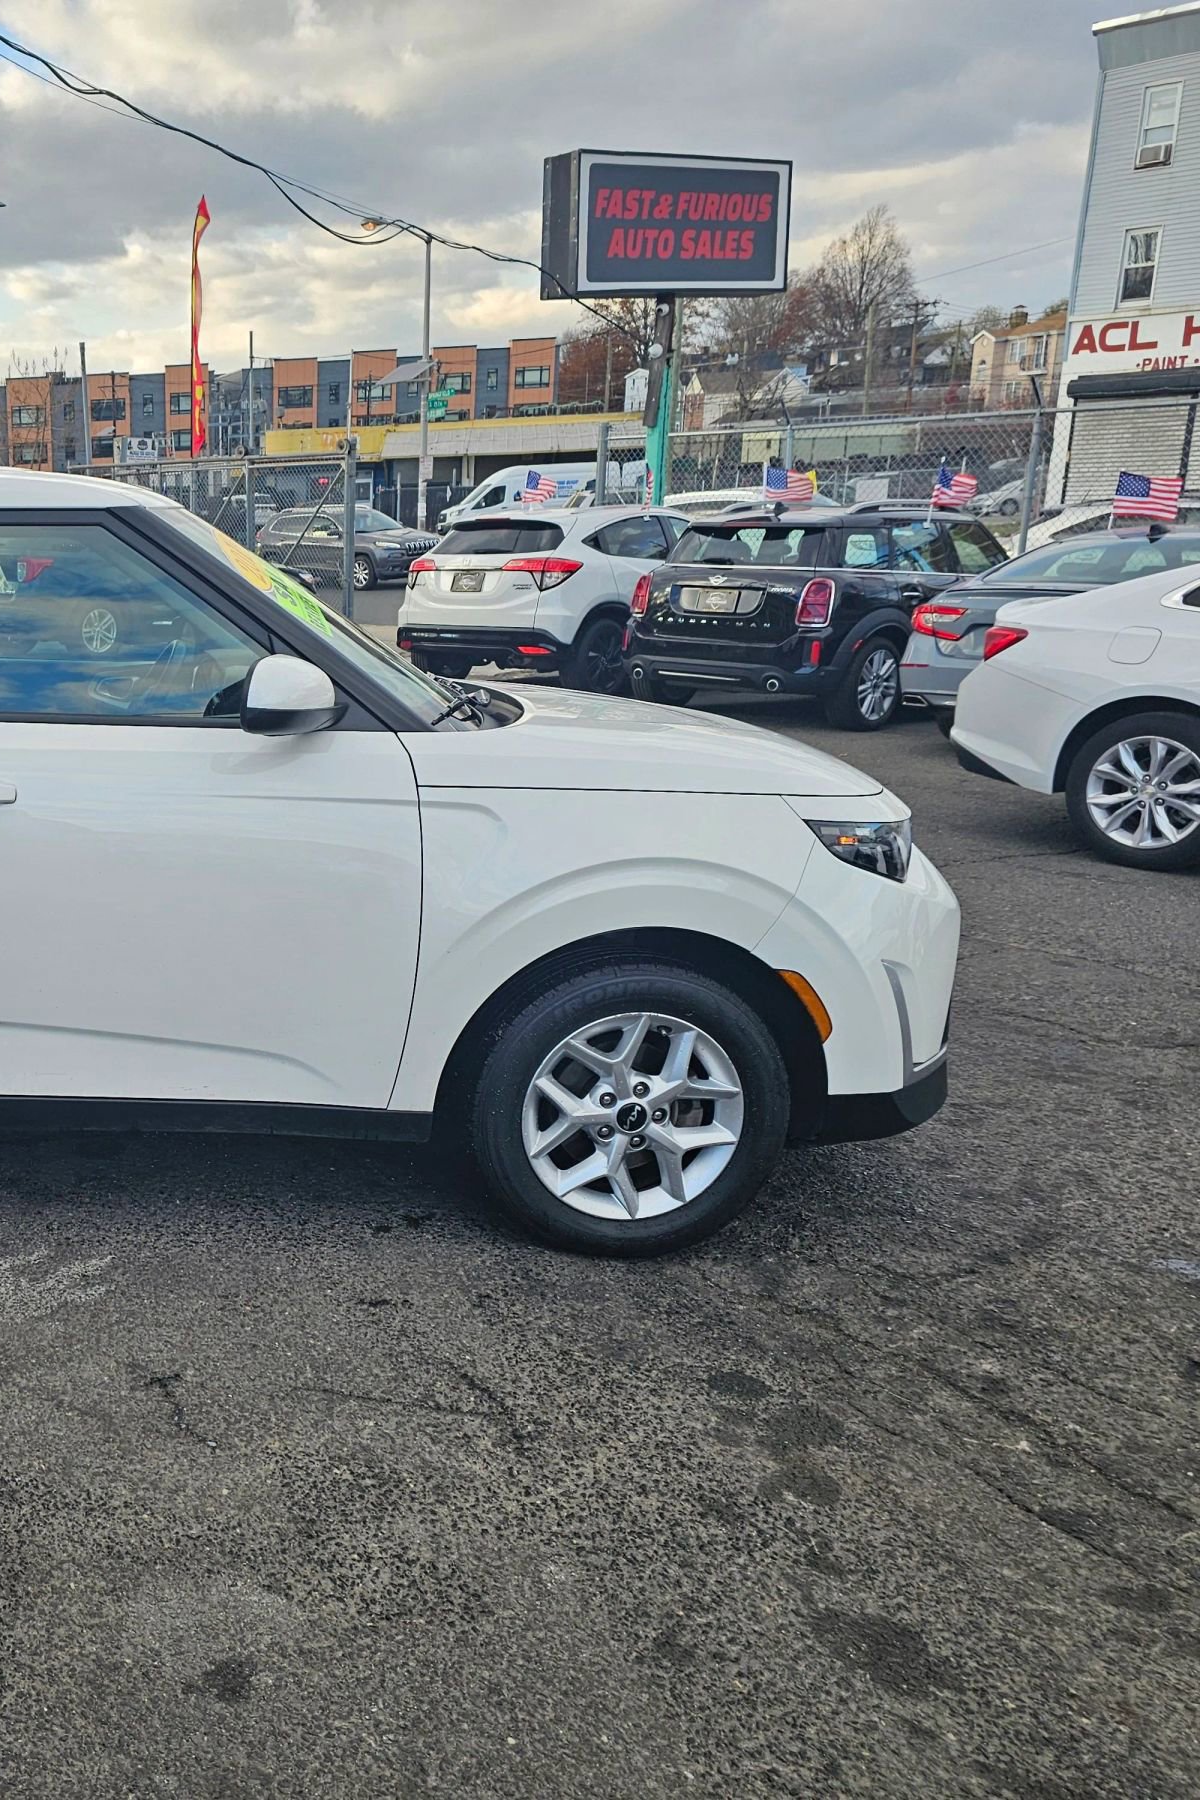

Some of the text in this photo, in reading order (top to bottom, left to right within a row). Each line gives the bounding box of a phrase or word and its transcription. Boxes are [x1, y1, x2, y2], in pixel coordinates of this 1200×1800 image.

[594, 188, 773, 222] FAST & FURIOUS
[607, 228, 755, 261] AUTO SALES
[1072, 320, 1158, 355] ACL
